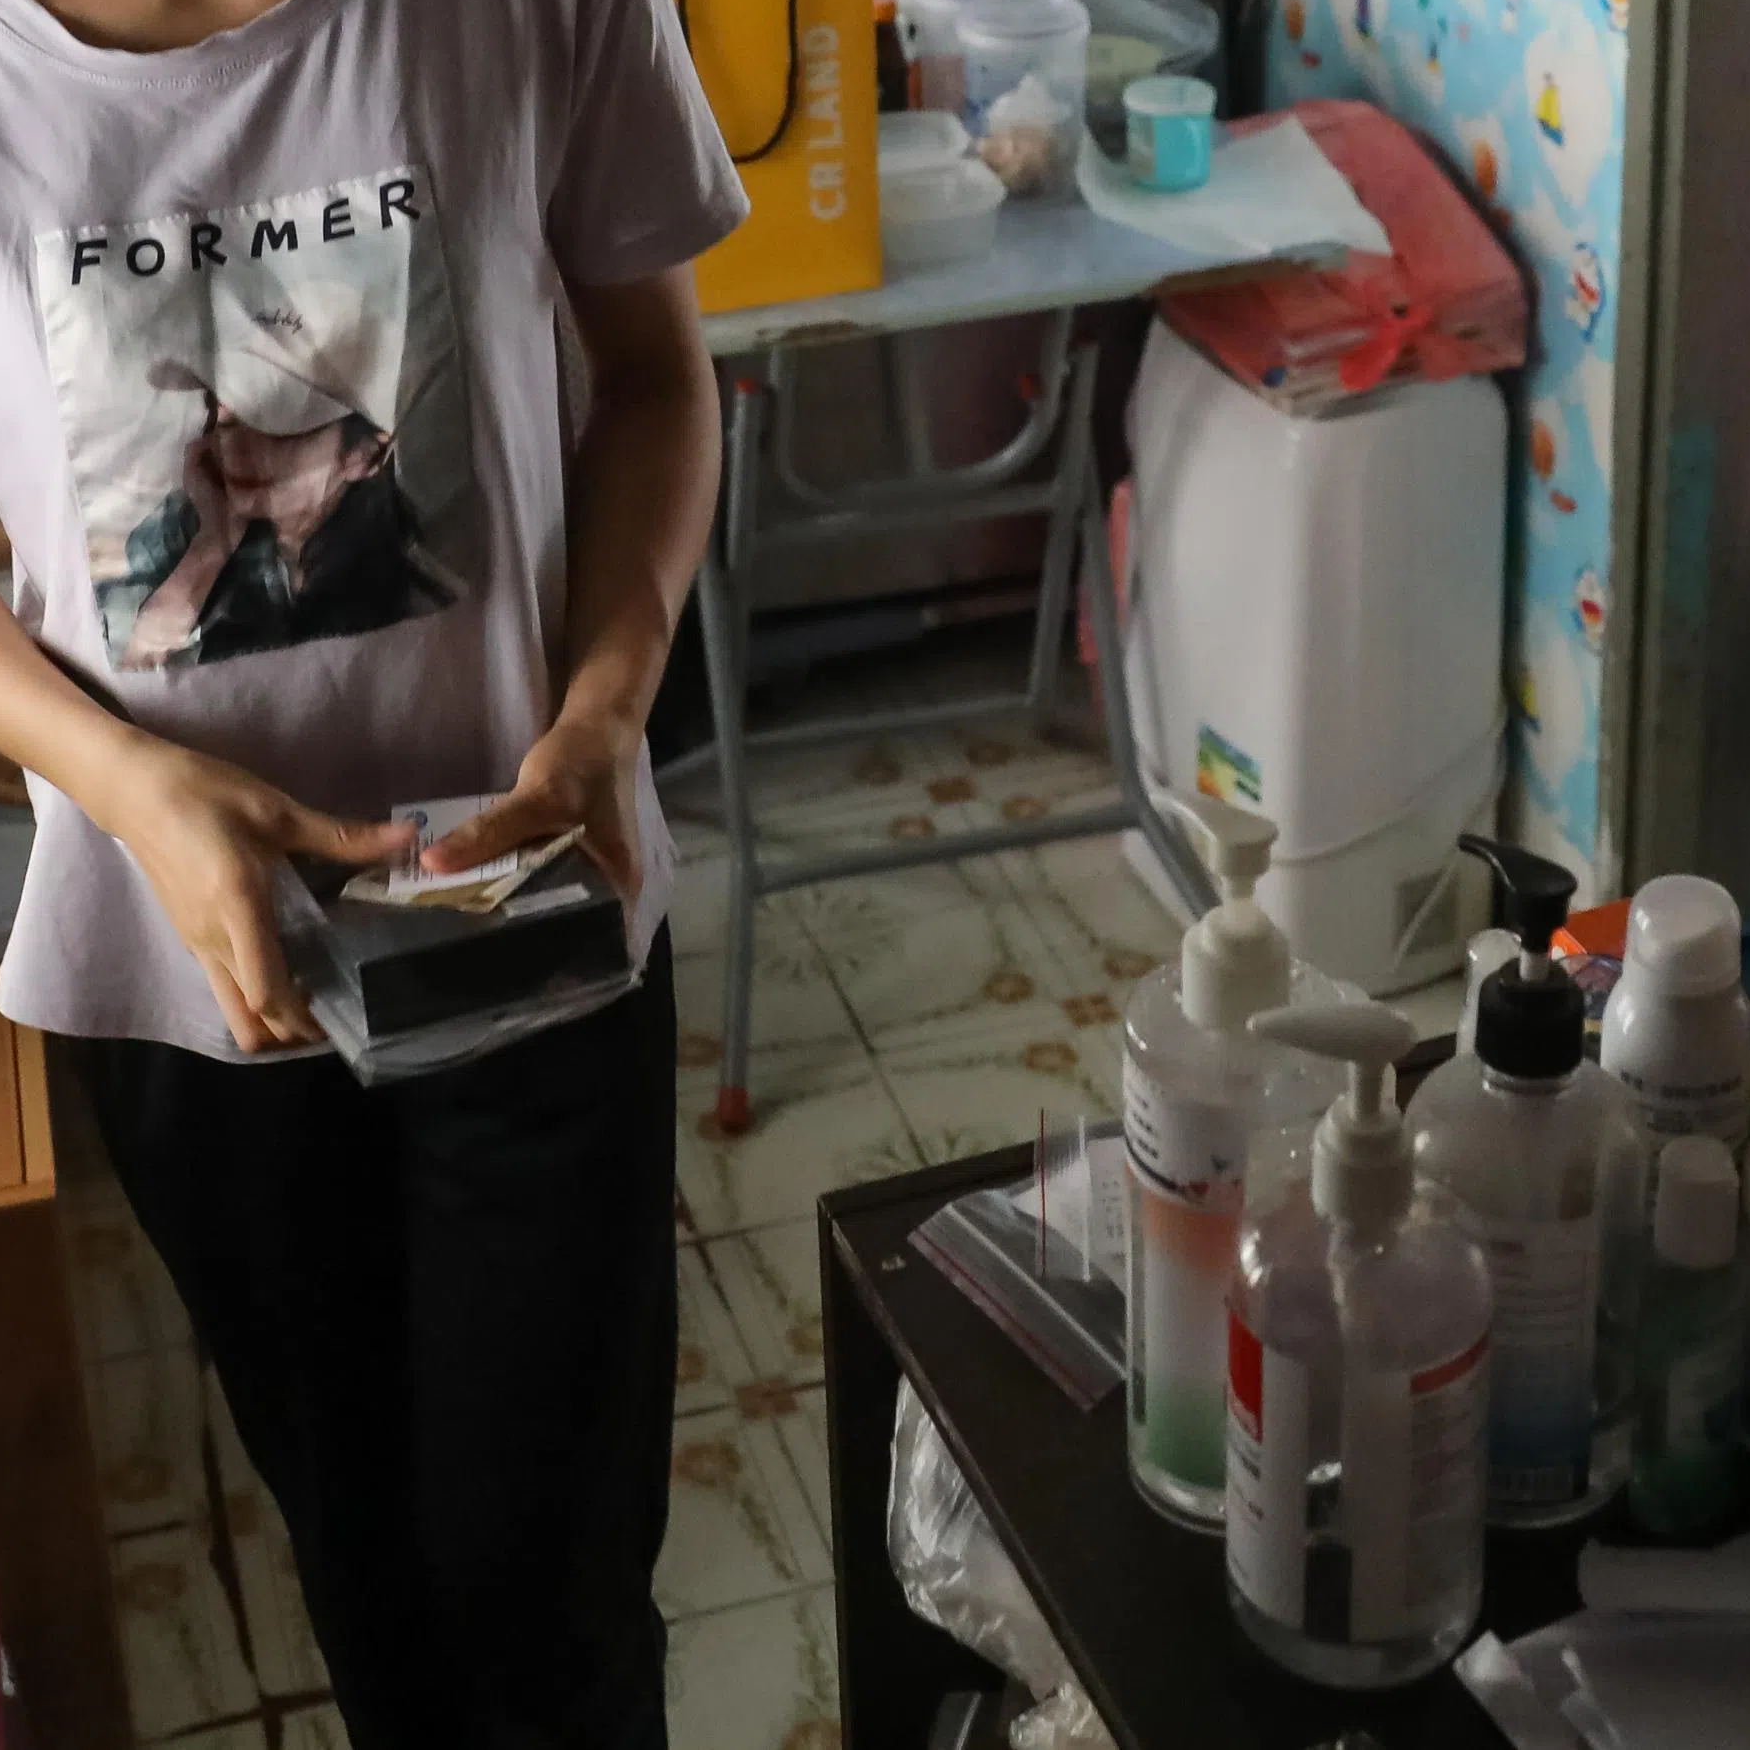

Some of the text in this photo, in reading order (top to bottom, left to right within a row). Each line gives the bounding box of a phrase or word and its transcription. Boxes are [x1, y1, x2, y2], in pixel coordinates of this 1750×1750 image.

[803, 24, 847, 221] CR LAND
[71, 179, 421, 286] FORMER
